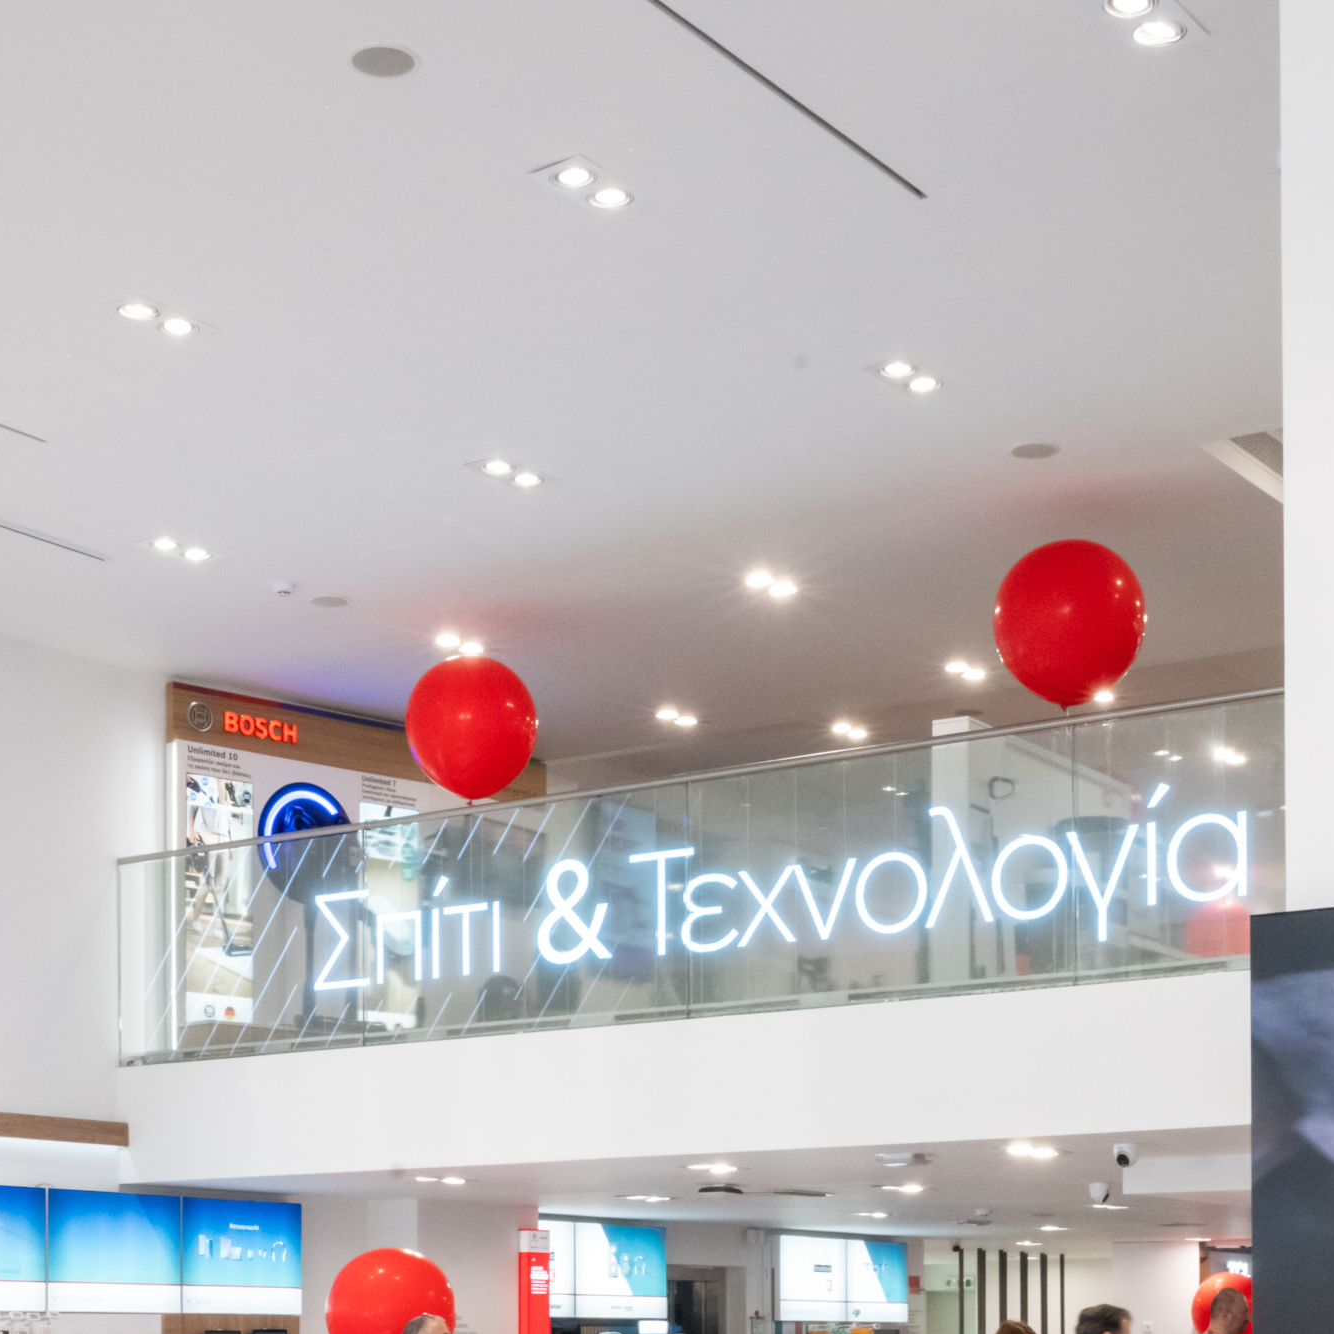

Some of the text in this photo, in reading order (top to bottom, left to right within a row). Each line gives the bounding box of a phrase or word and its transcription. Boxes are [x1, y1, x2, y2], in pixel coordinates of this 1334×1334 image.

[224, 710, 298, 744] BOSCH
[187, 745, 238, 761] Unlimited 10
[313, 782, 1249, 991] Σπίτι & Τεχνολογία
